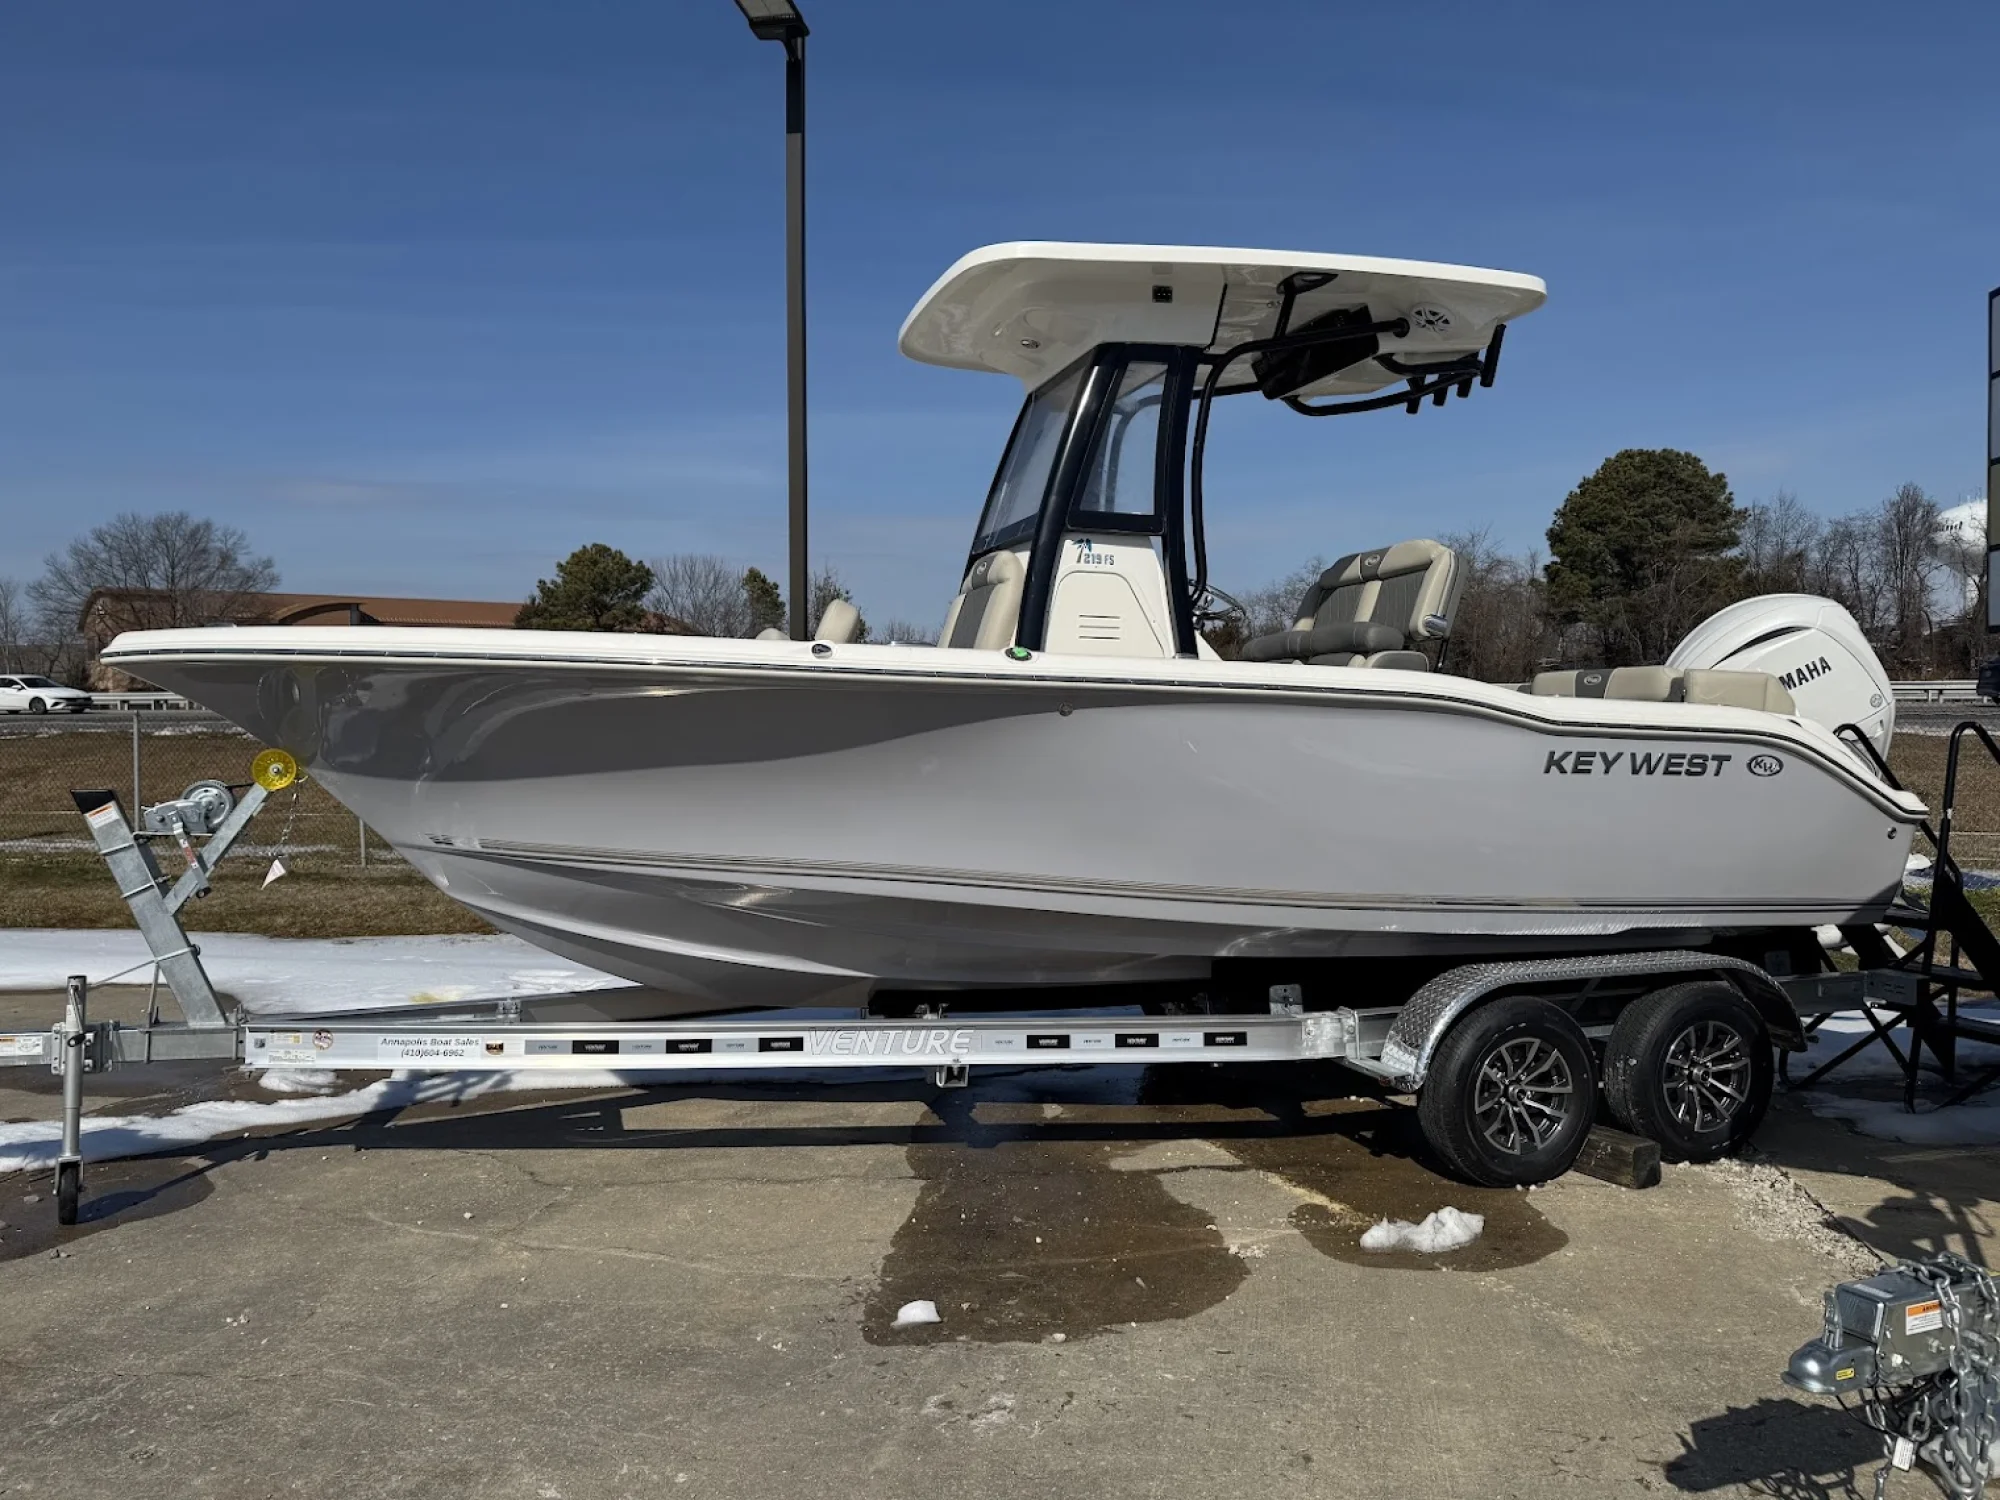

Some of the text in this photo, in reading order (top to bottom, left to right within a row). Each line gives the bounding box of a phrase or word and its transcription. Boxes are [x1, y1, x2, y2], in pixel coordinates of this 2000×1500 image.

[1083, 552, 1115, 566] 219 FS
[1778, 656, 1832, 690] MAHA
[1543, 750, 1732, 777] KEY WEST
[380, 1037, 480, 1048] Annapolis Boat Sales
[808, 1026, 977, 1055] VENTURE
[400, 1048, 465, 1058] (410)604-6962
